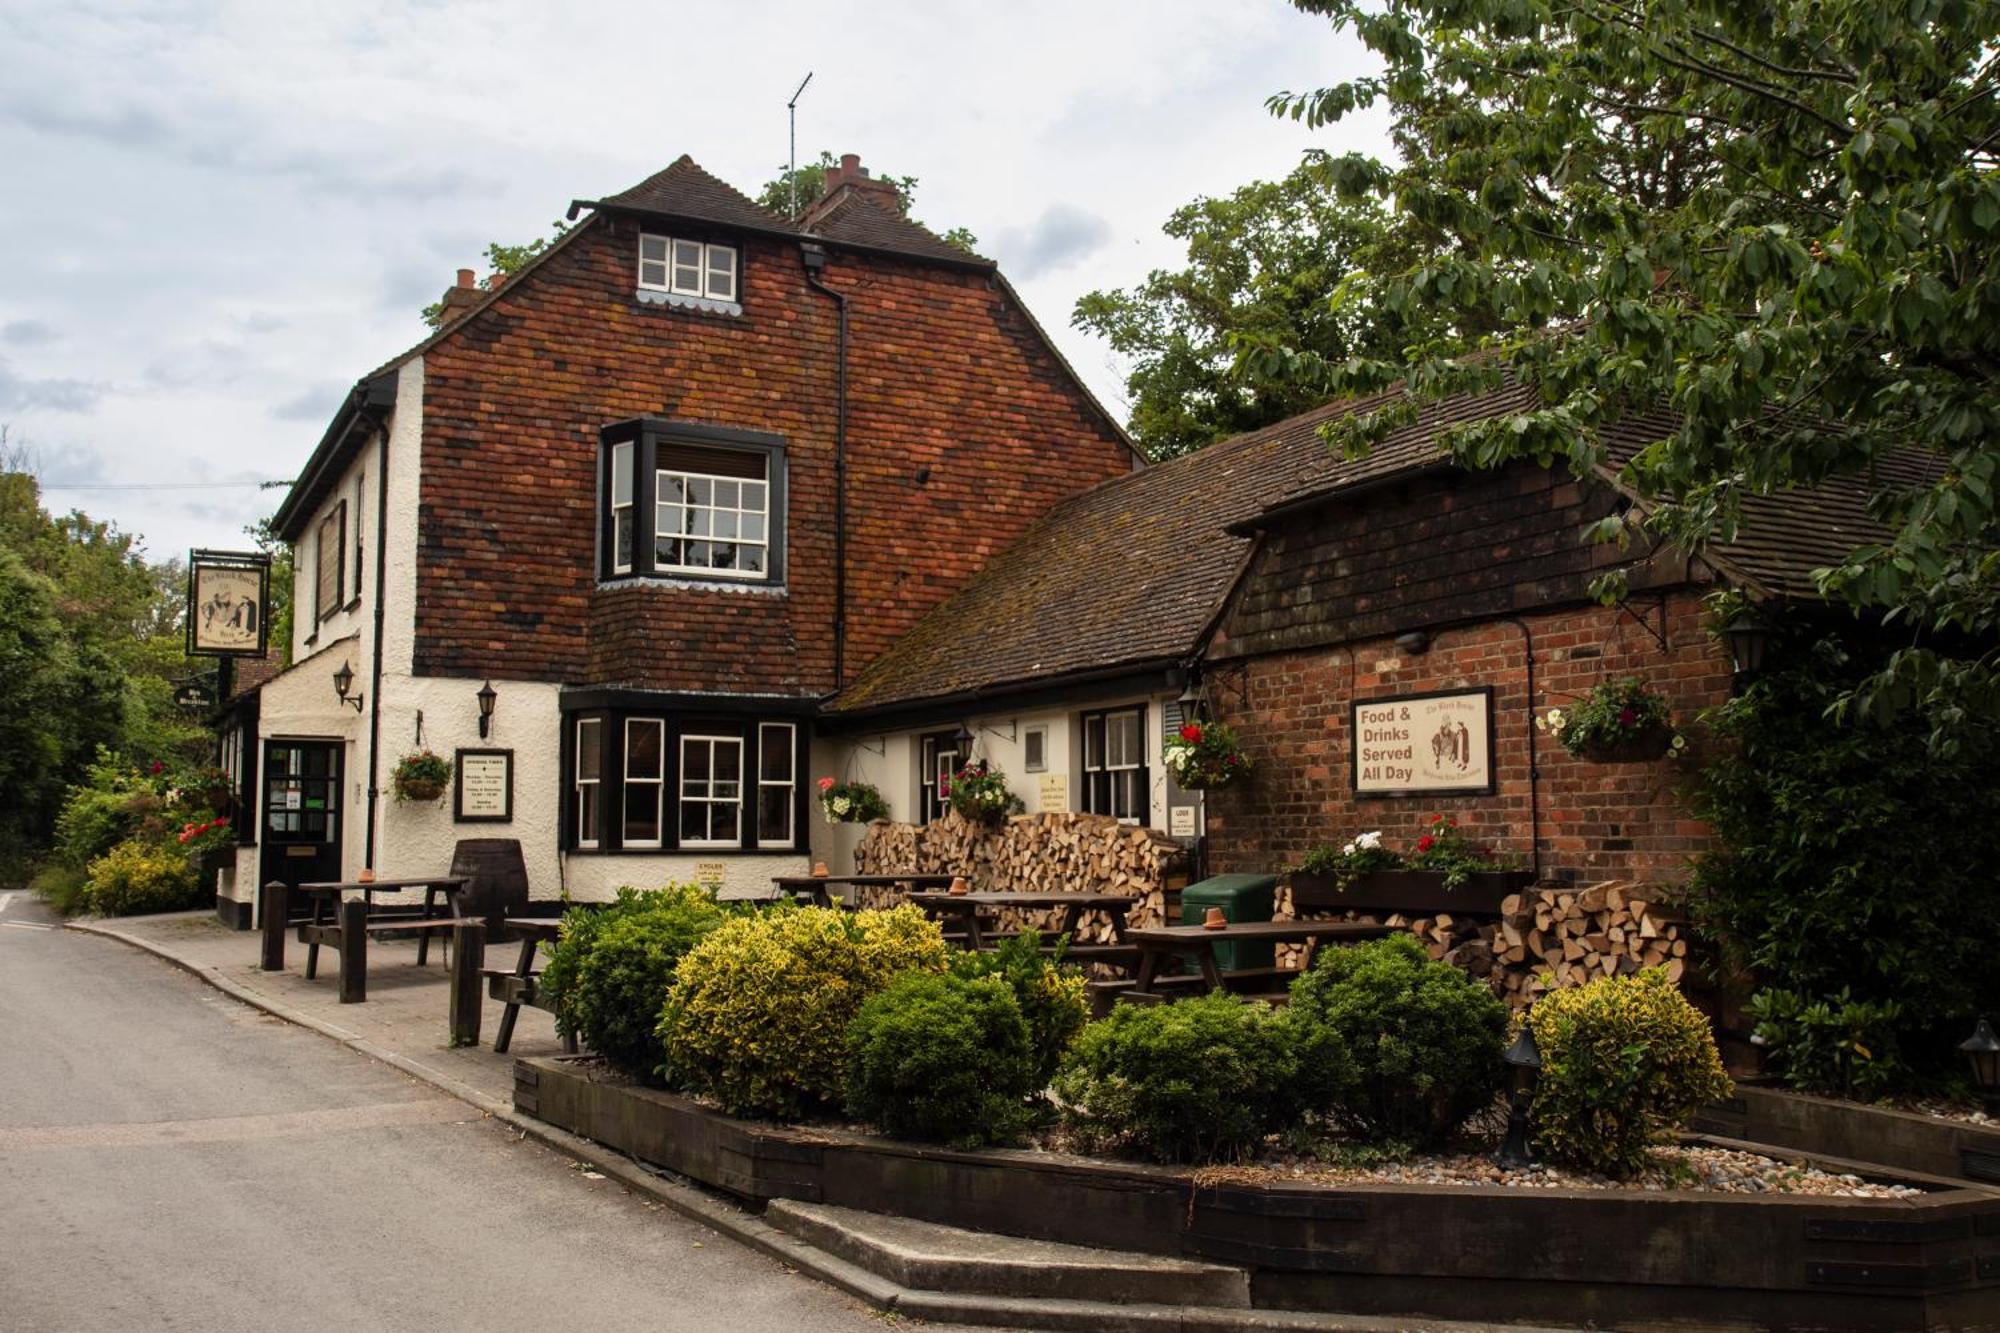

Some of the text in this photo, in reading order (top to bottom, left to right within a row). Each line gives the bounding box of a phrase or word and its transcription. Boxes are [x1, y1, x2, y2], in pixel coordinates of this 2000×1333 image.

[1361, 706, 1410, 724] Food &
[1364, 727, 1409, 743] Drinks
[1362, 745, 1412, 761] Served
[1362, 766, 1381, 780] All
[1386, 765, 1412, 782] Day
